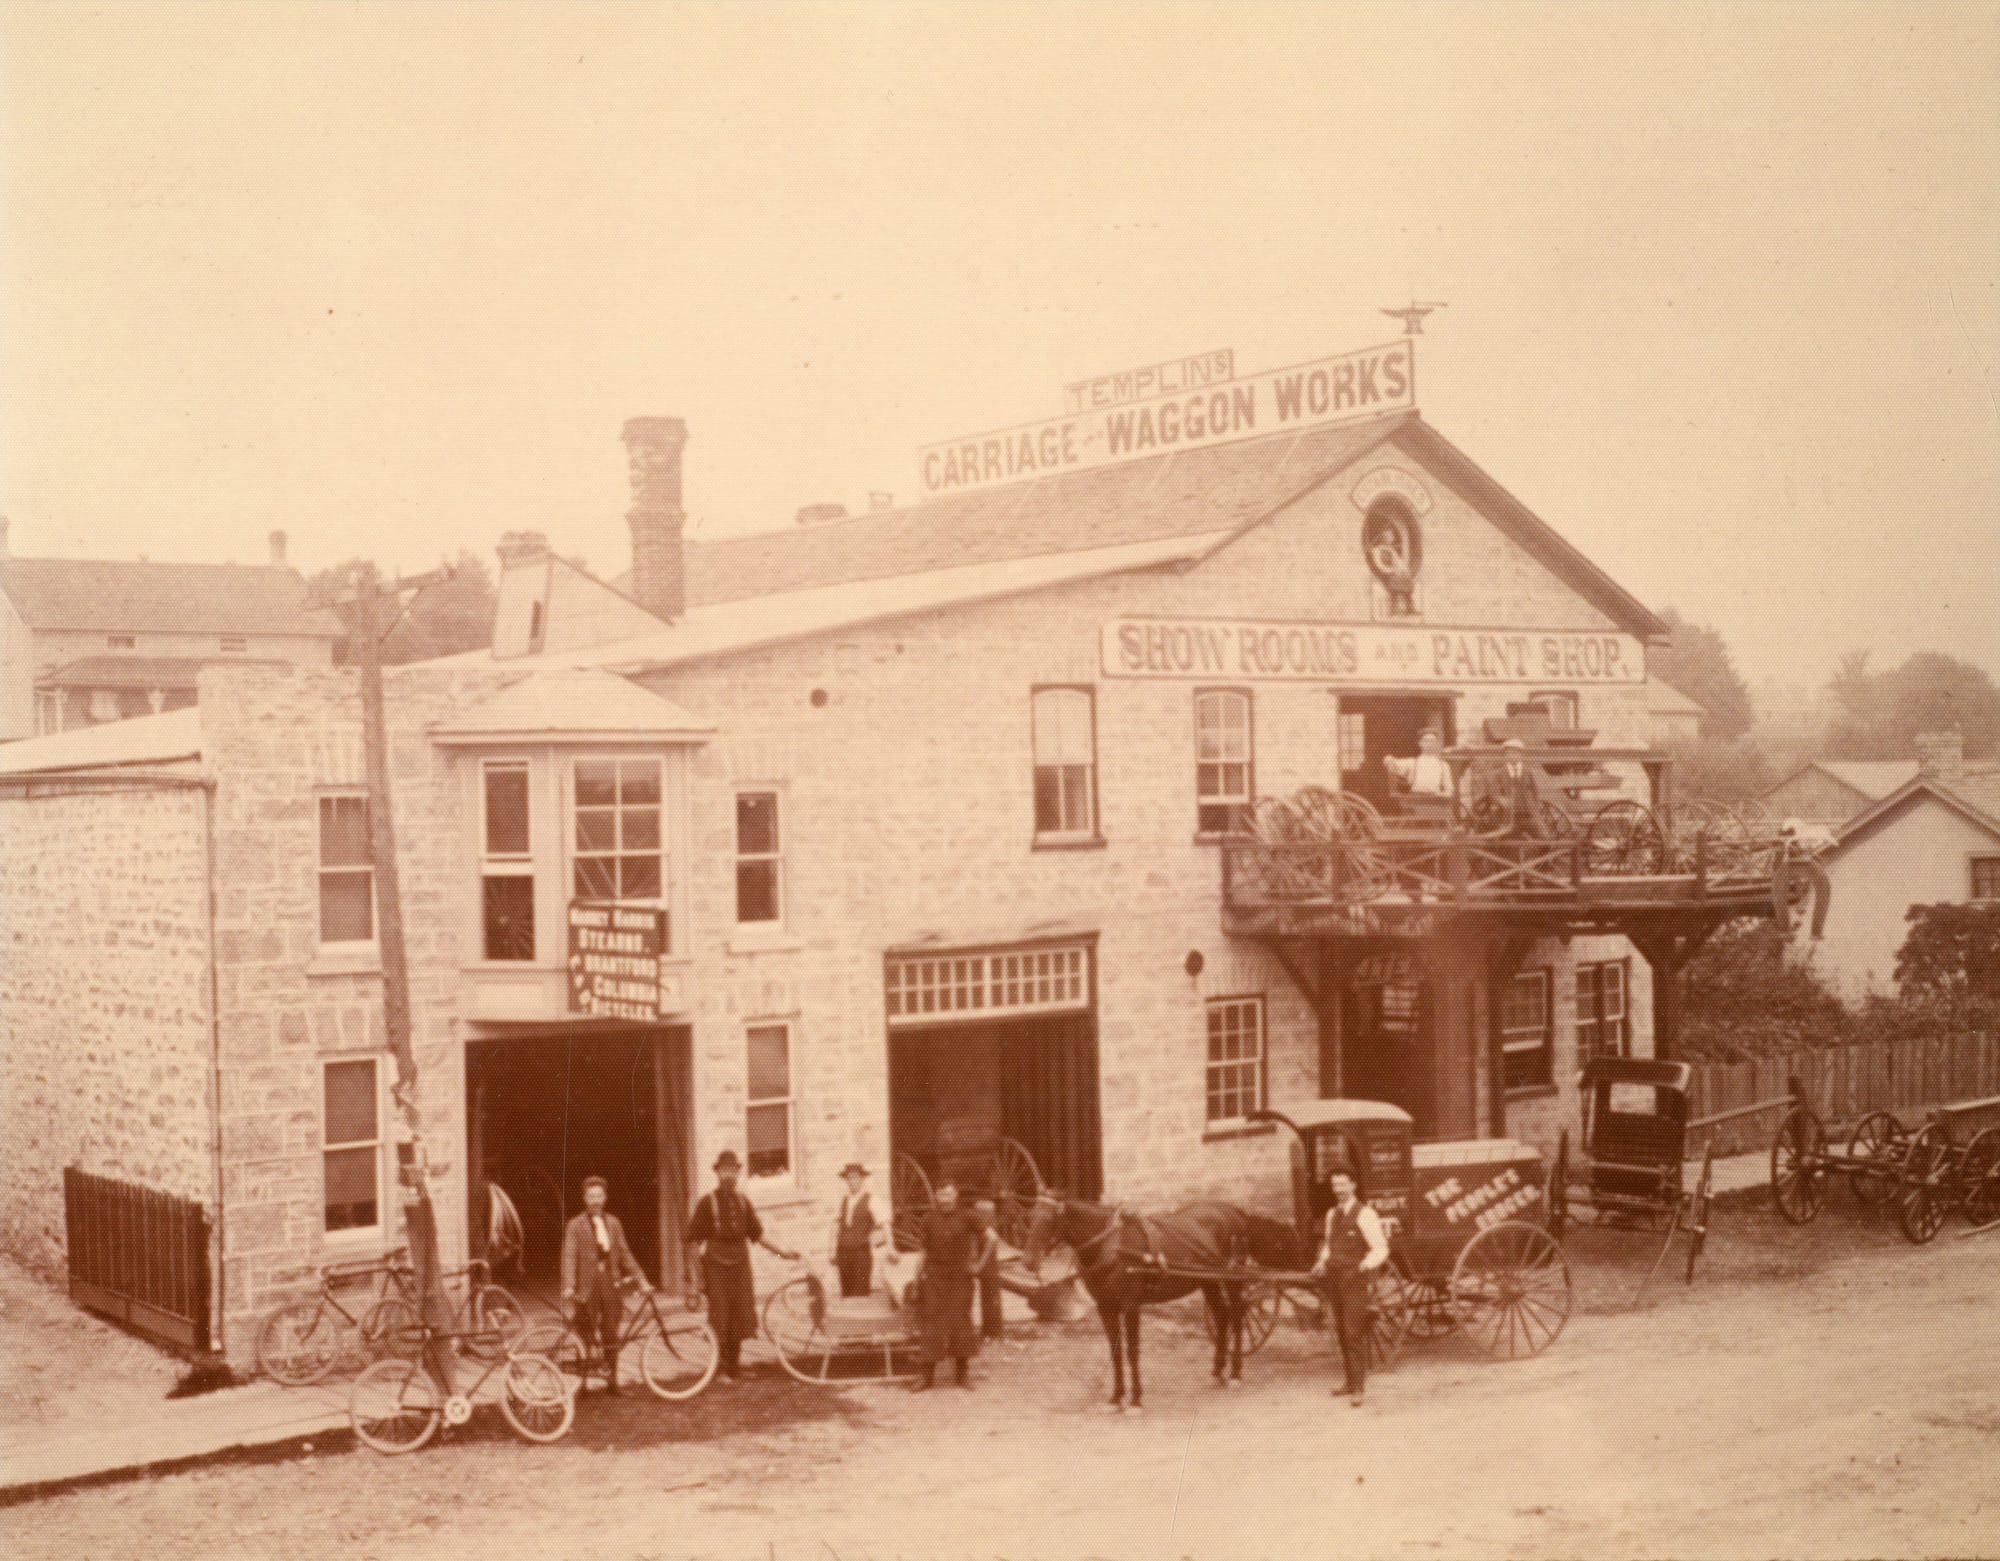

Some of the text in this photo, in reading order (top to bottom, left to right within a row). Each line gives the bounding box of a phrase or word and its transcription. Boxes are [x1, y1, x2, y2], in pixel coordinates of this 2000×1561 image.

[924, 352, 1407, 491] CARRIAGE WAGGON WORKS
[1119, 624, 1231, 671] SHOW
[1238, 627, 1358, 673] ROOMS
[1374, 641, 1419, 662] AND
[1432, 634, 1528, 678] PAINT
[1425, 1177, 1462, 1207] THE
